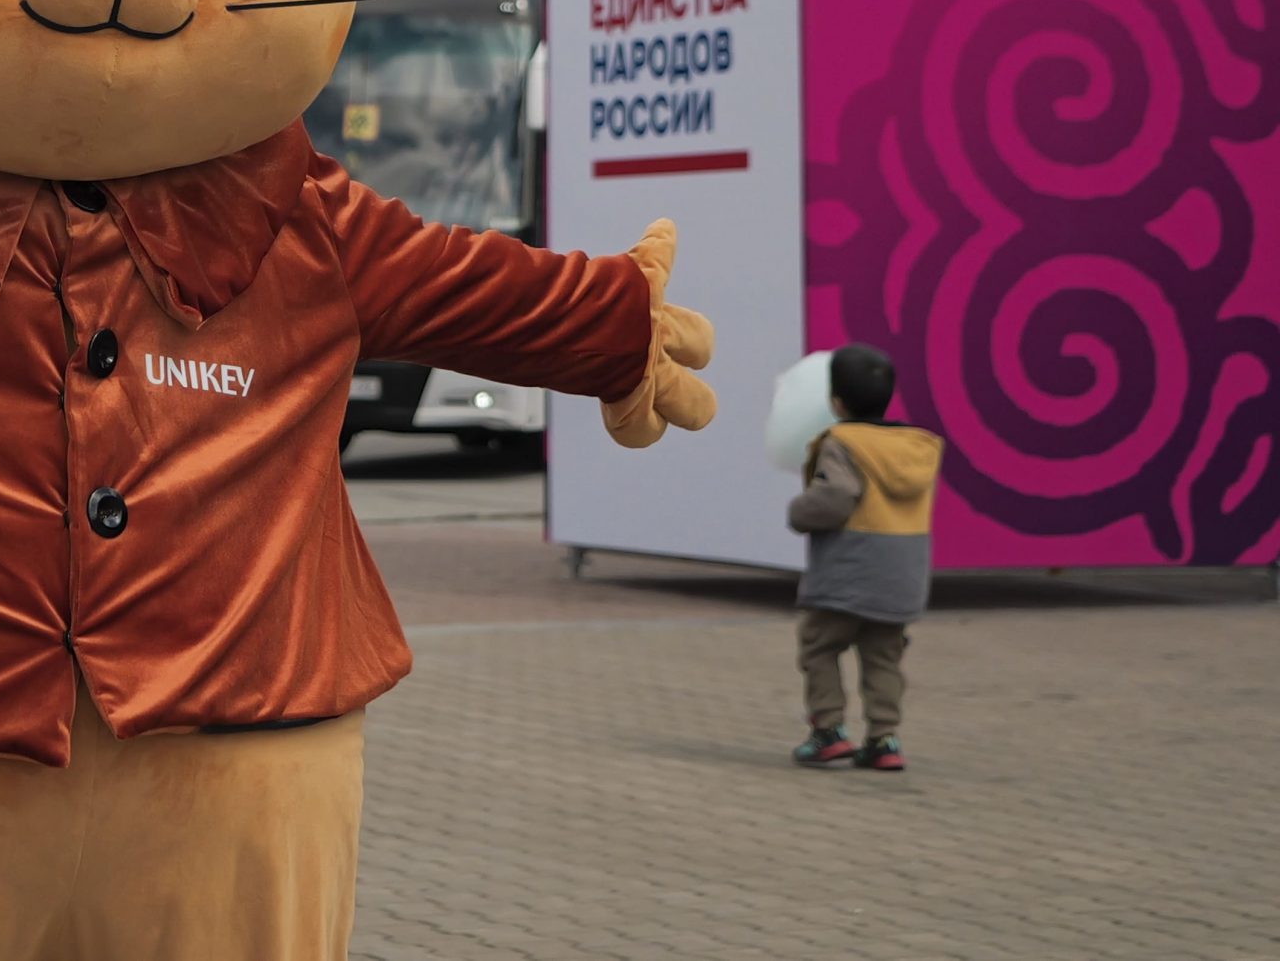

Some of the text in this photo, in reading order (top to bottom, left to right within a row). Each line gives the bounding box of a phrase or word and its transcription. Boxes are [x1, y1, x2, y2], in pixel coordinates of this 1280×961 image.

[590, 28, 732, 85] НАРОДОВ
[590, 91, 715, 140] РОССИИ
[144, 353, 256, 398] UNIKEY
